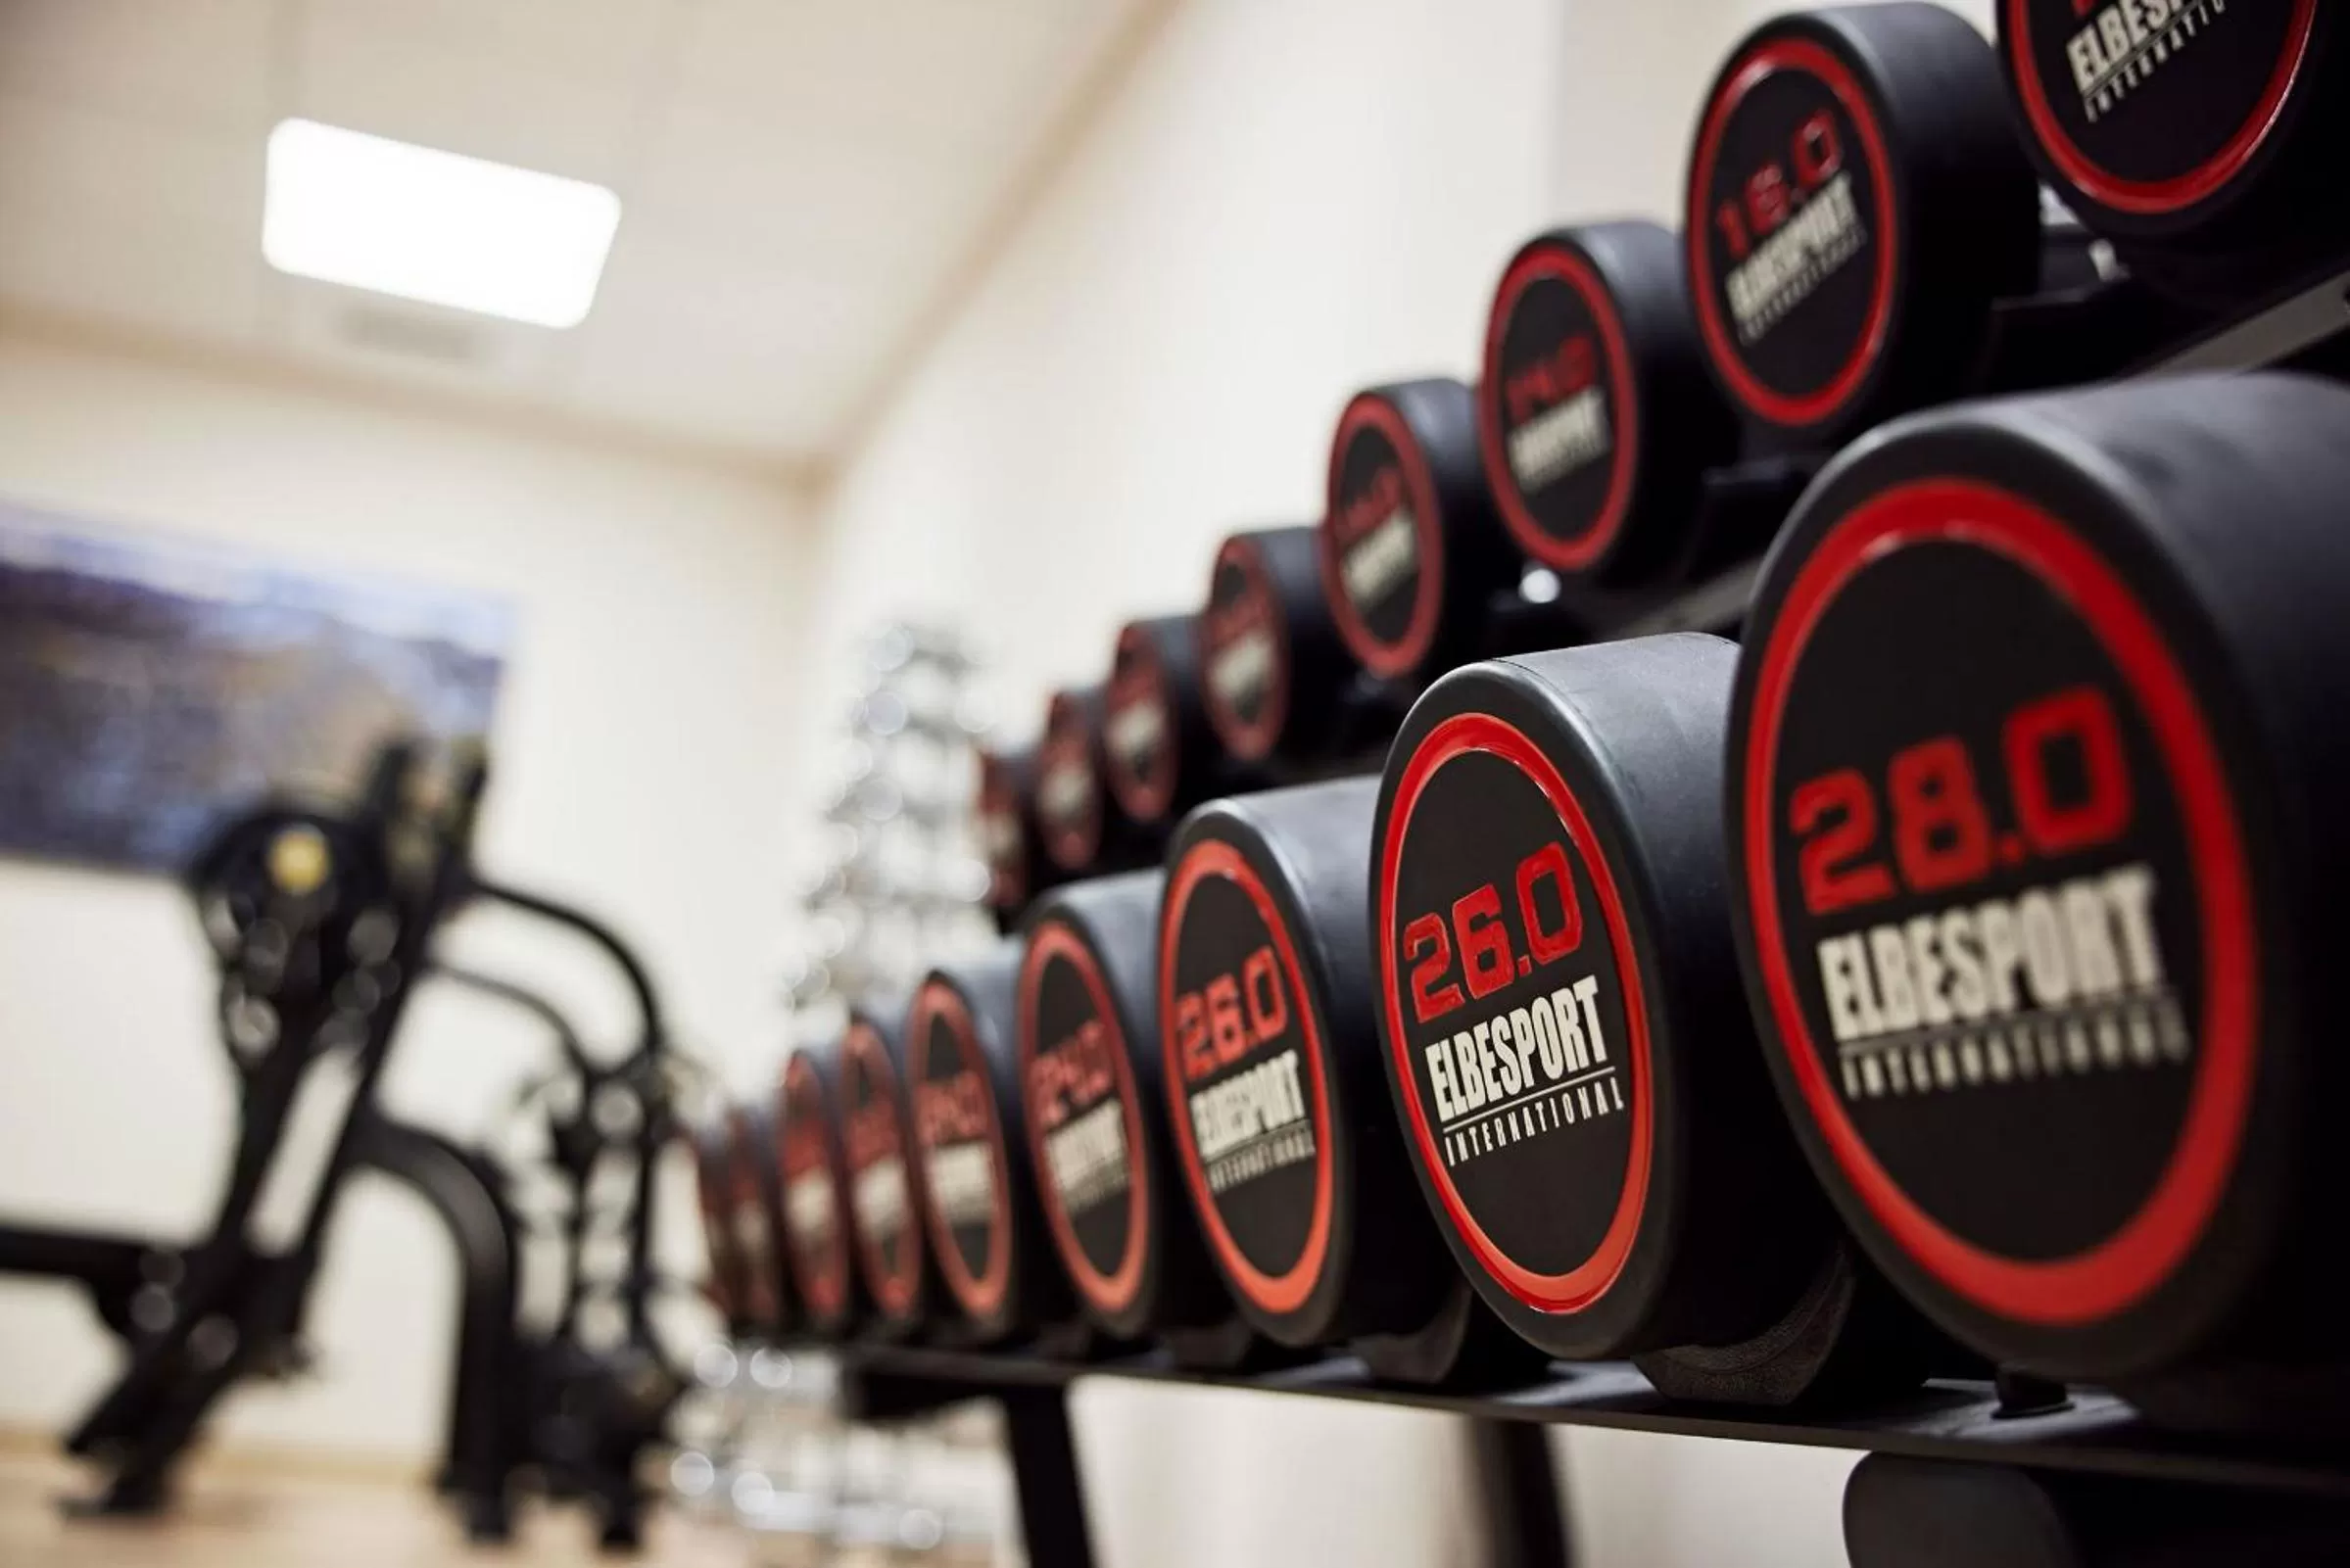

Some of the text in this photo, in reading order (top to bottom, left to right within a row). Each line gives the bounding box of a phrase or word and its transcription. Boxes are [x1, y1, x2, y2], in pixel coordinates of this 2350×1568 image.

[2066, 0, 2183, 93] ELBES
[1789, 684, 2133, 917] 28.0
[1403, 840, 1583, 1023] 26.0
[1817, 860, 2158, 1042] ELBESPORT
[1176, 945, 1287, 1082] 26.0
[1425, 974, 1607, 1122] ELBESPORT
[1445, 1076, 1624, 1166] INTERNATIONAL
